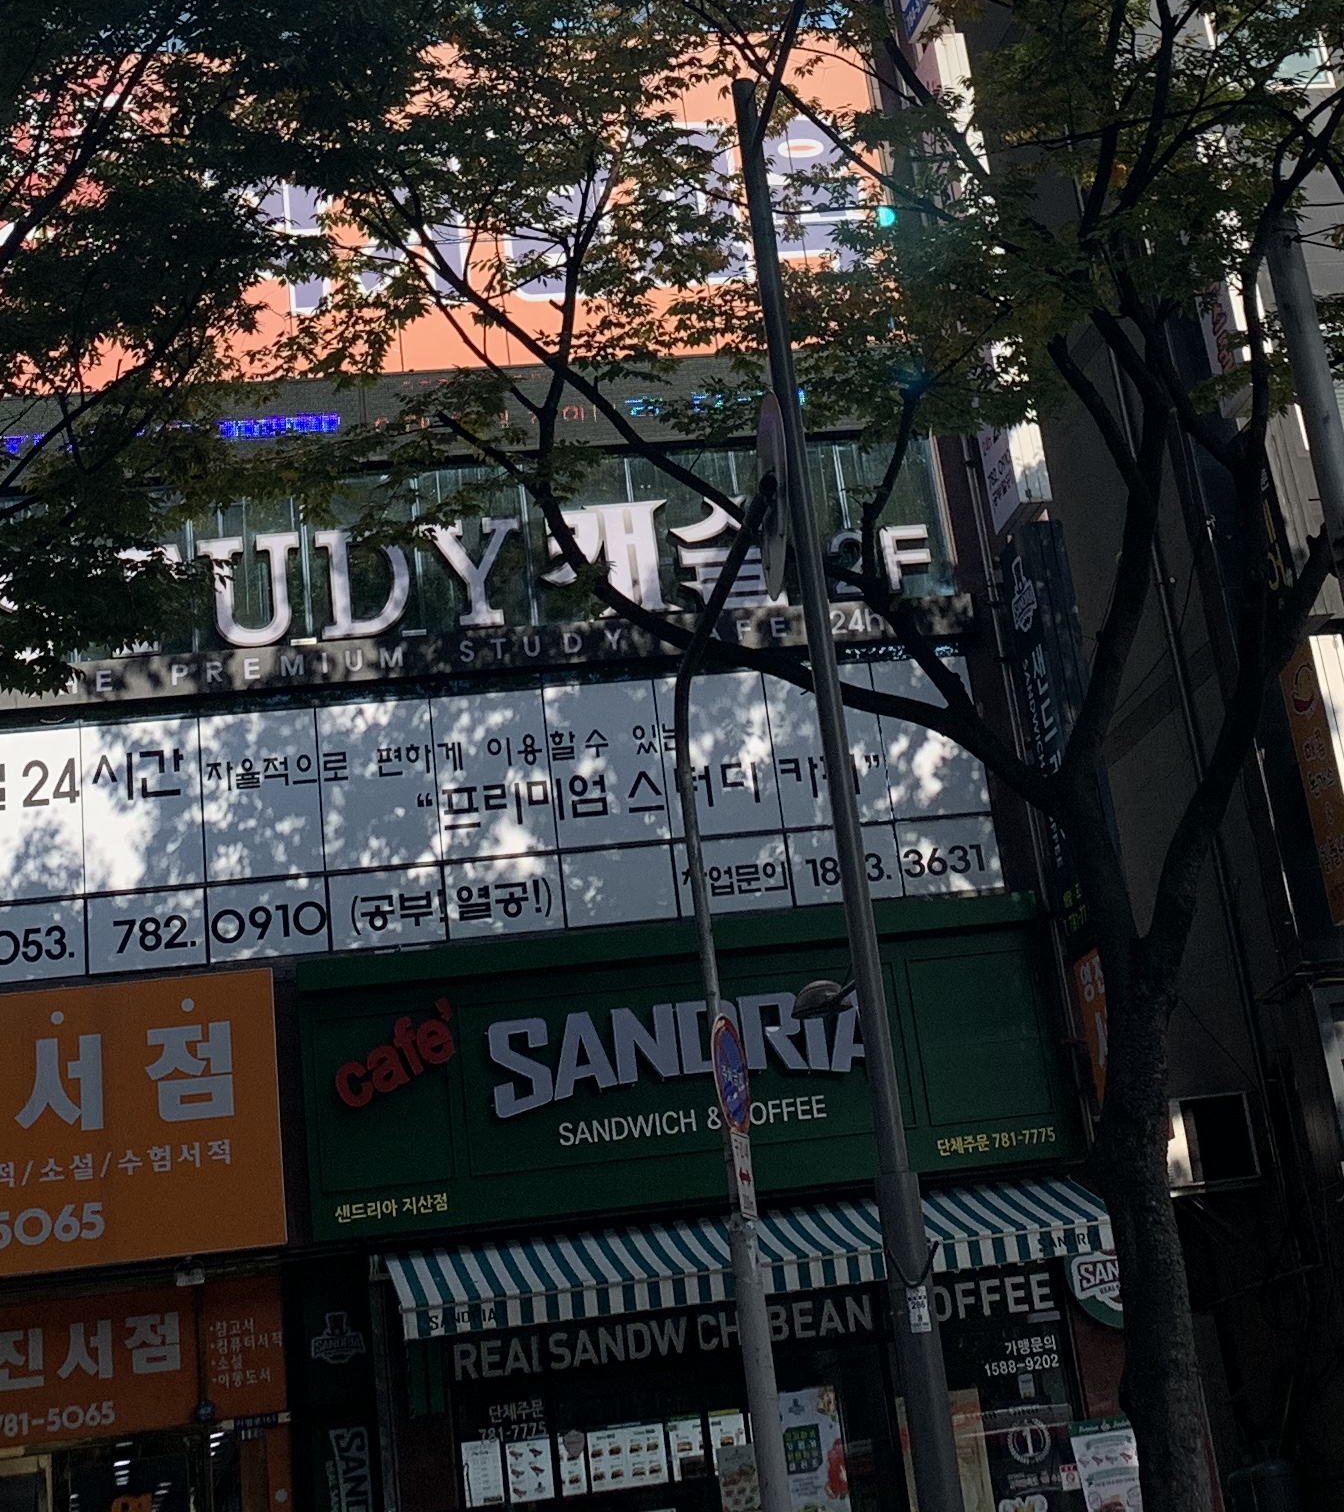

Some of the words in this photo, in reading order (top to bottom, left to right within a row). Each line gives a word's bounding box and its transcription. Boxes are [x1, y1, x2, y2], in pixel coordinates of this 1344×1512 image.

[170, 646, 404, 686] PREMIUM
[460, 627, 623, 663] STUDY
[829, 607, 887, 636] 24h
[22, 756, 81, 808] 24
[91, 748, 185, 802] 시간
[206, 750, 350, 792] 자율적으로
[376, 741, 464, 778] 편하게
[113, 913, 198, 955] 782.
[210, 899, 328, 945] 0910
[805, 852, 892, 887] 183.
[903, 842, 987, 879] 3631
[558, 1109, 698, 1148] SANDWICH
[706, 1108, 723, 1131] &
[748, 1094, 828, 1125] OFFEE
[937, 1135, 991, 1158] 단체주문
[993, 1126, 1057, 1150] 781-7775
[334, 1203, 398, 1224] 샌드리아
[402, 1193, 449, 1215] 지산점
[1004, 1337, 1057, 1356] 가맹문의
[983, 1354, 1060, 1377] 1588-9202
[487, 1400, 545, 1423] 단체주문
